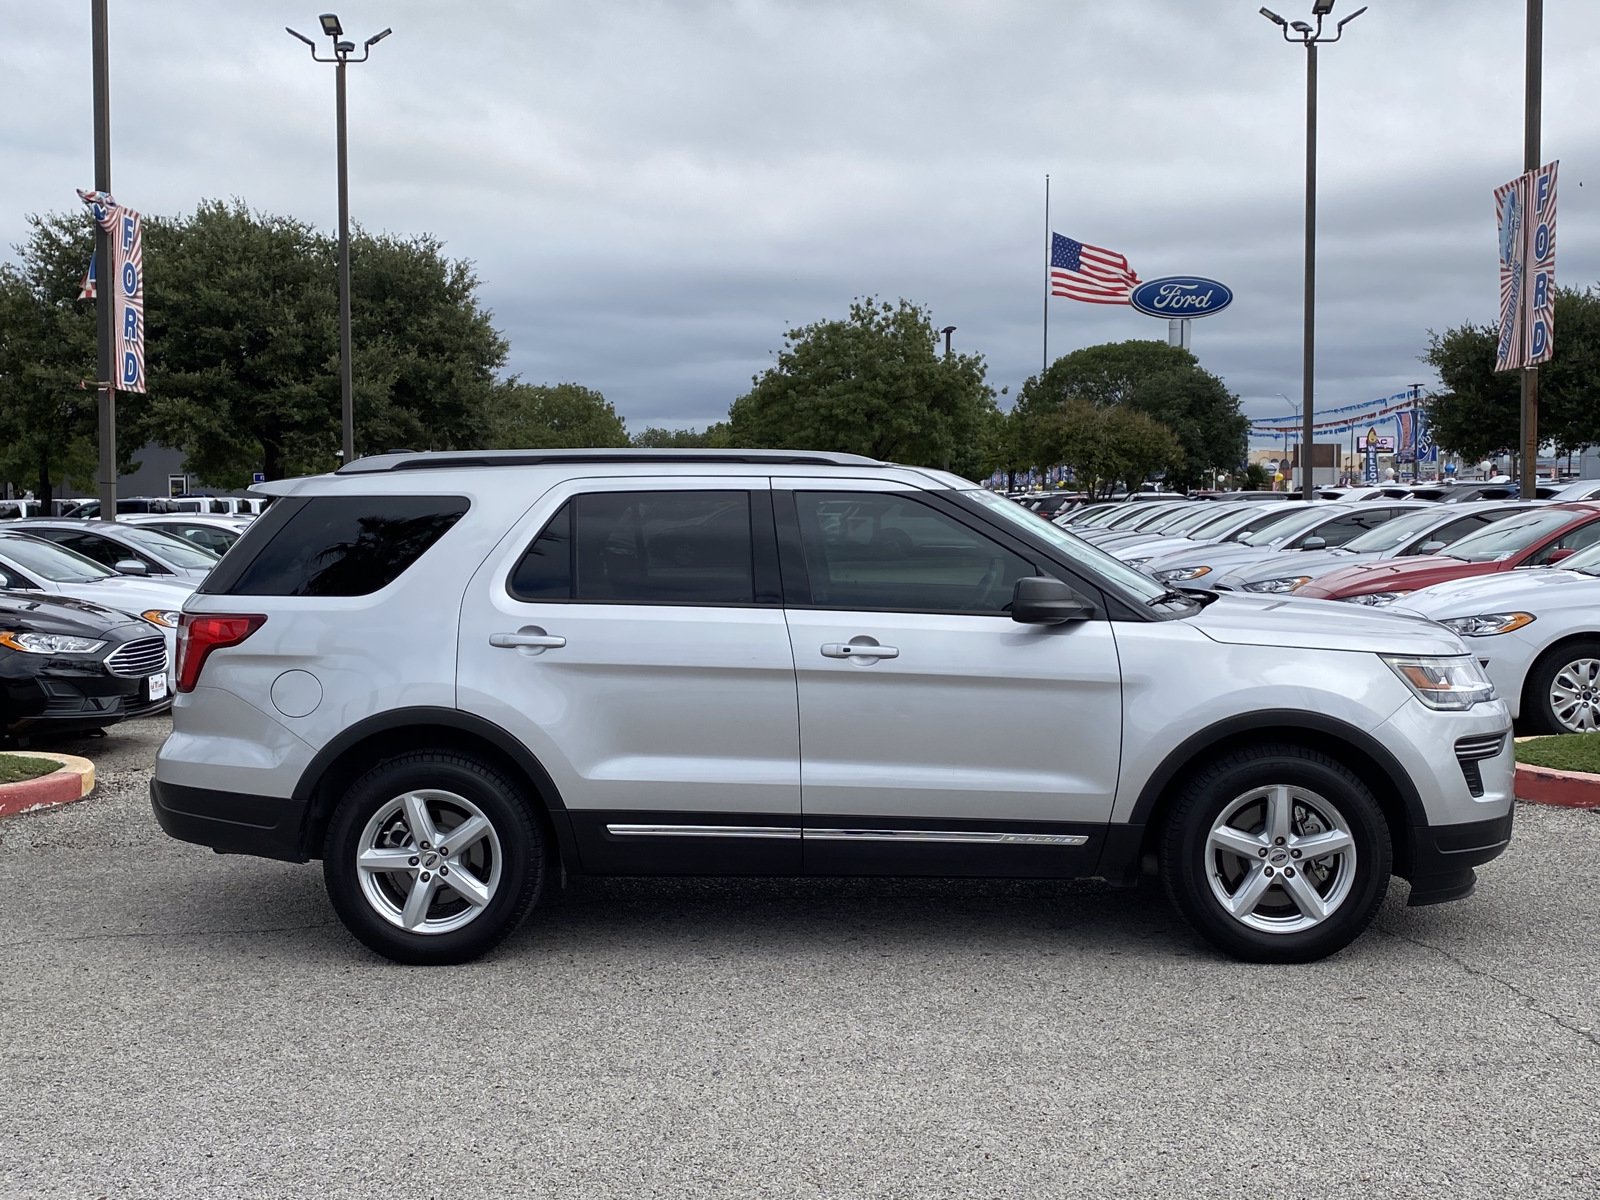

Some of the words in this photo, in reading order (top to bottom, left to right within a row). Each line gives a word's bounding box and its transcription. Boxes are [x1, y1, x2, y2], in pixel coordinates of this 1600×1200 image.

[122, 217, 139, 386] FORD
[1153, 283, 1214, 308] Ford
[1532, 174, 1549, 358] FORD
